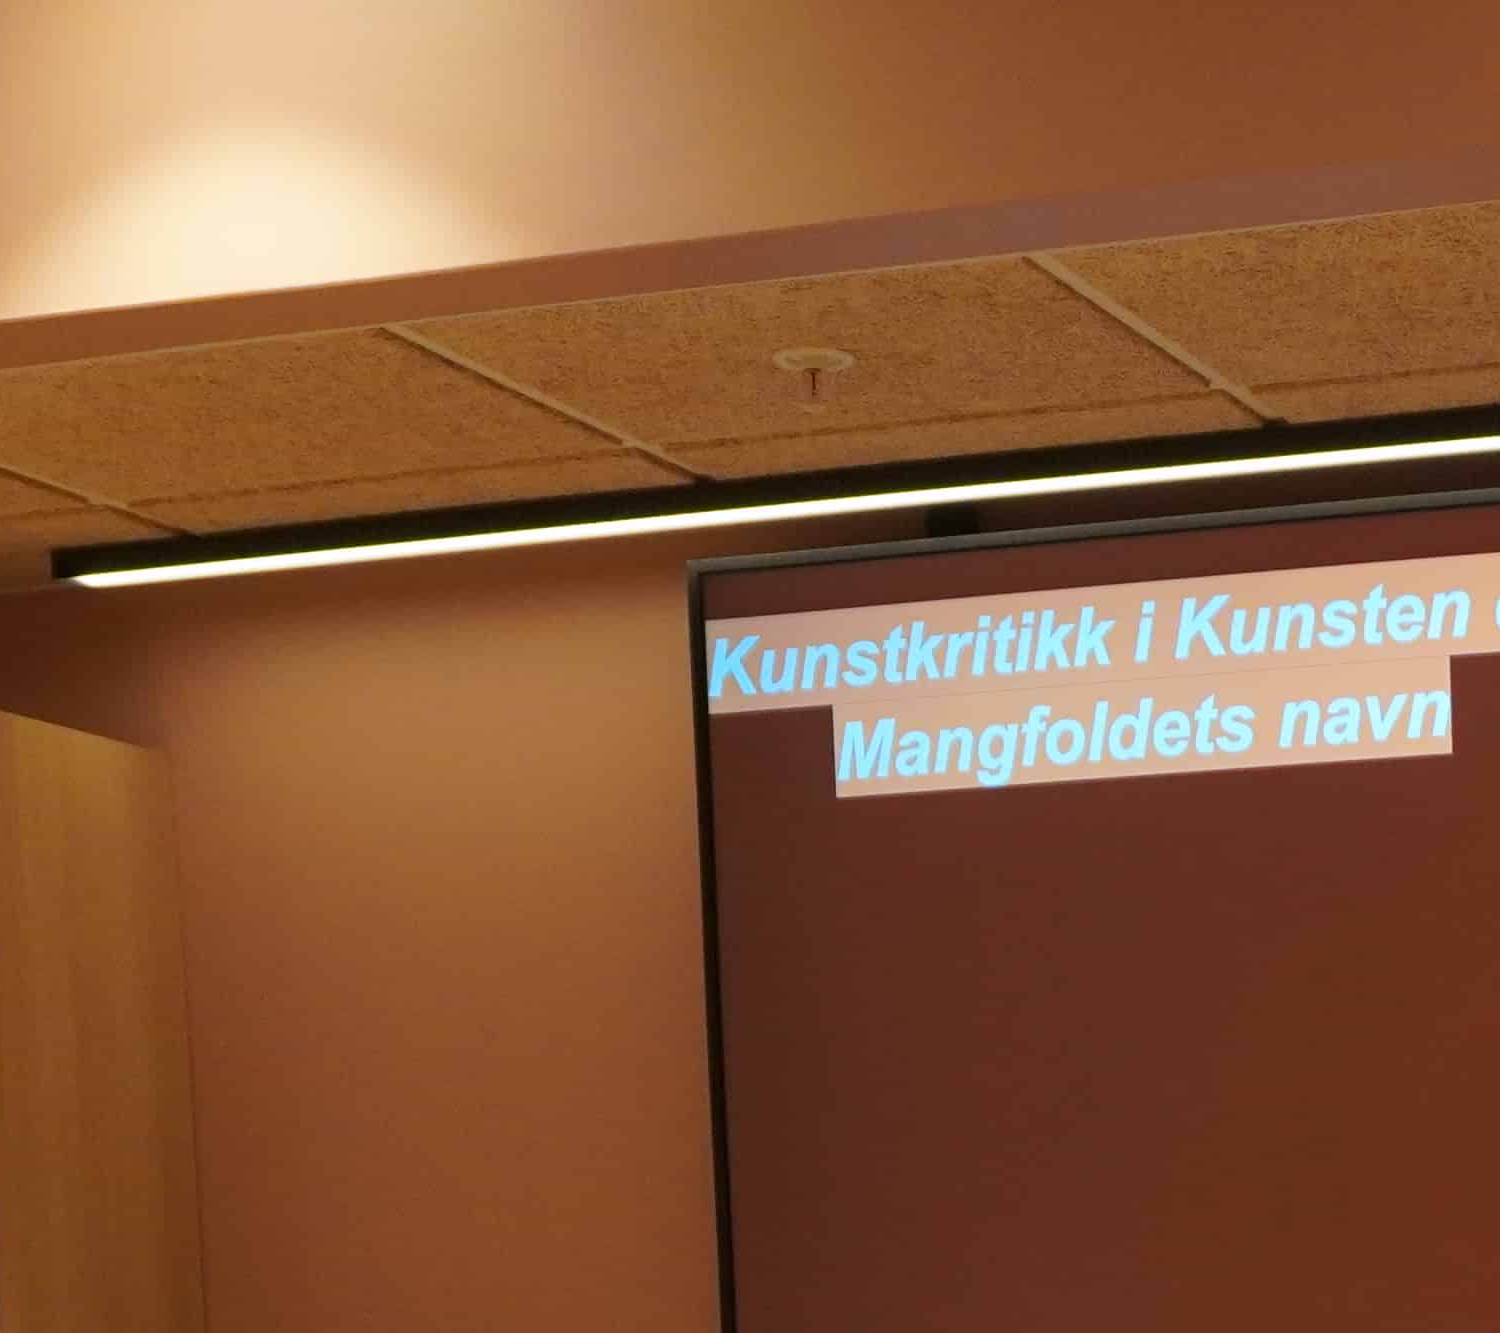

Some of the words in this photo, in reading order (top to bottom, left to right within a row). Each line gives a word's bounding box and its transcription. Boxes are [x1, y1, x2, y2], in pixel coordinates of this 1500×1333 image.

[706, 605, 1115, 700] Kunstkritikk
[1134, 600, 1157, 663] i
[1174, 585, 1471, 660] Kunsten
[835, 694, 1255, 789] Mangfoldets
[1278, 691, 1452, 748] navn
